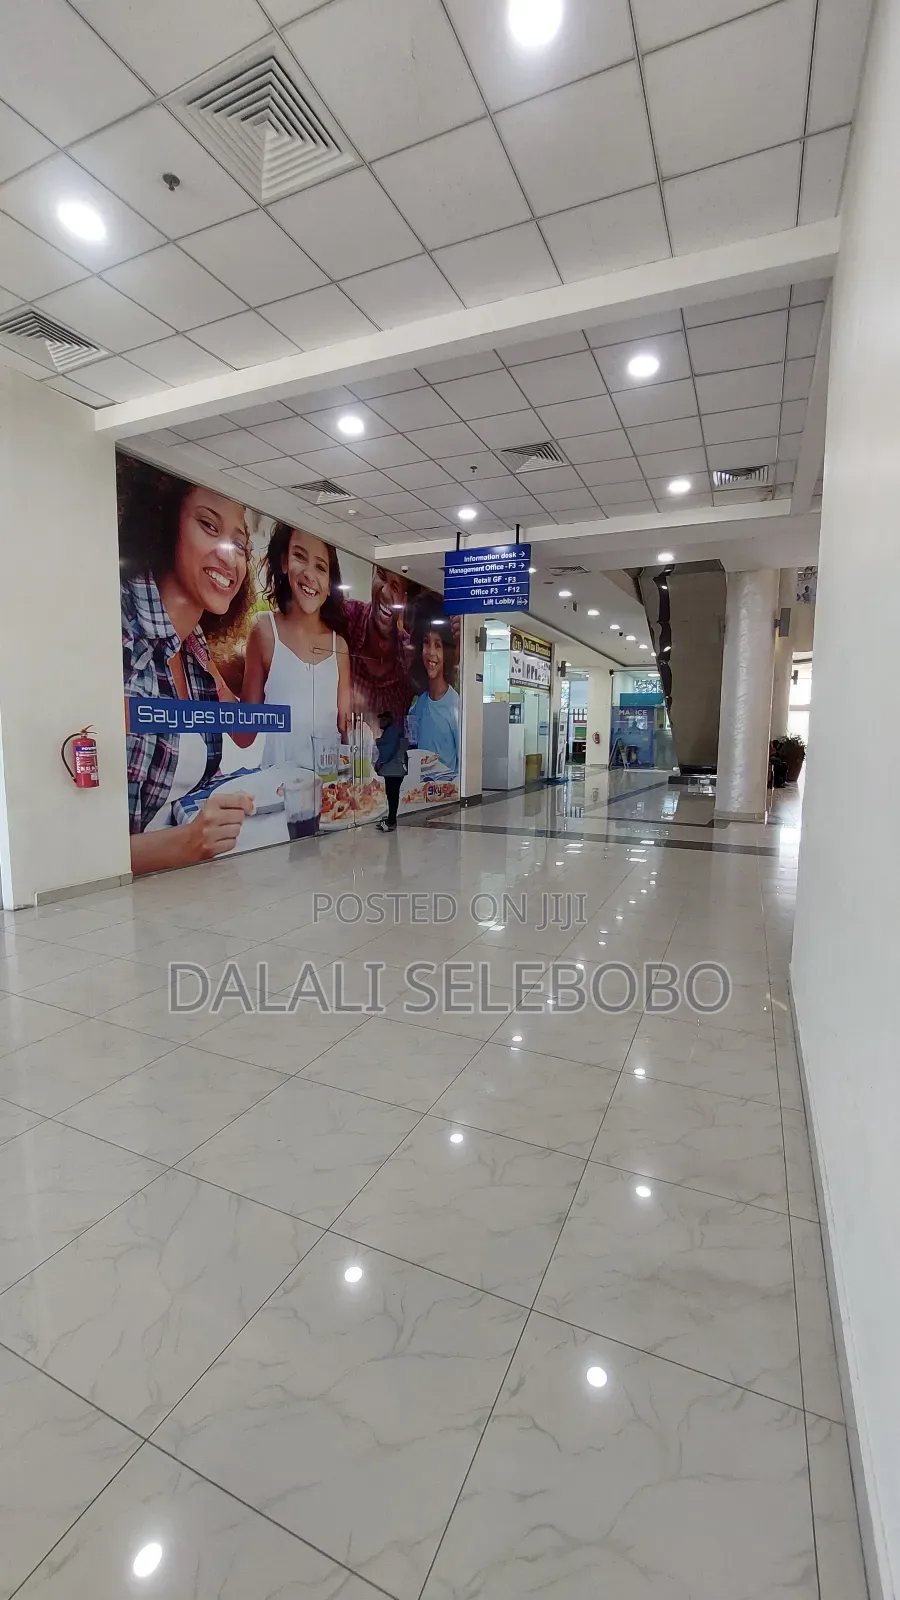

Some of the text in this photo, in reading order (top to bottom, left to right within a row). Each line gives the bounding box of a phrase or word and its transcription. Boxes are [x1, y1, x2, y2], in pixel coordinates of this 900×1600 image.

[464, 551, 517, 562] Information desk
[449, 565, 485, 574] Management
[485, 563, 504, 572] Office
[473, 577, 491, 585] Retail
[470, 588, 489, 596] Office
[495, 598, 515, 606] Lobby
[137, 705, 285, 729] Say yes to tummy
